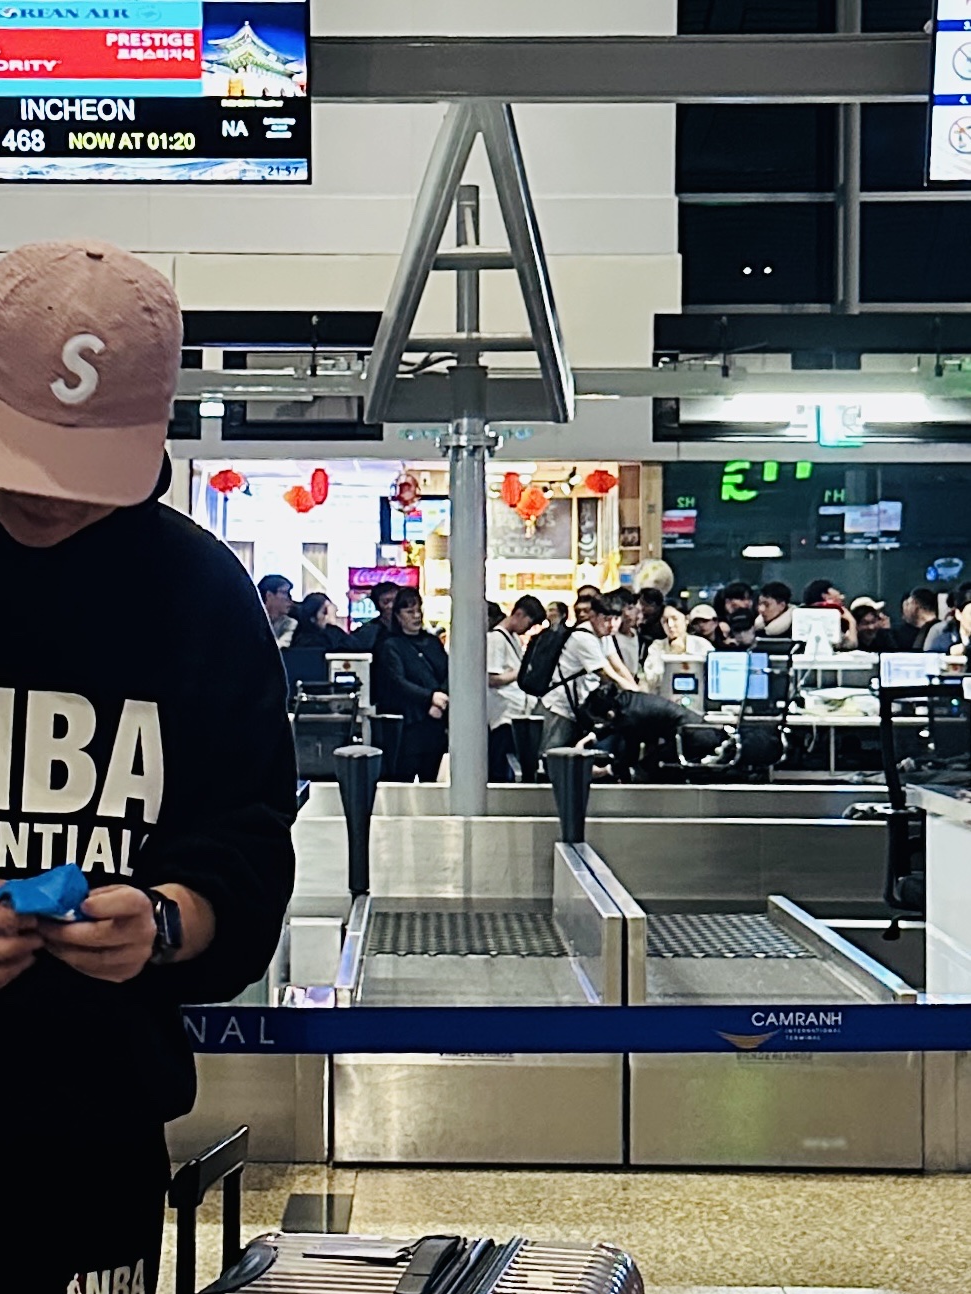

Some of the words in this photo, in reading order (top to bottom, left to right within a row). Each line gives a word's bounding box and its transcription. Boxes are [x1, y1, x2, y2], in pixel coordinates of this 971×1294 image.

[86, 7, 130, 19] AIR
[105, 33, 195, 48] PRESTIGE
[20, 98, 135, 122] INCHEON
[221, 120, 248, 137] NA
[2, 129, 46, 152] 468
[68, 132, 115, 150] NOW
[118, 132, 143, 150] AT
[147, 132, 196, 151] 01:20
[50, 332, 106, 404] S
[751, 1011, 842, 1026] CAMRANH
